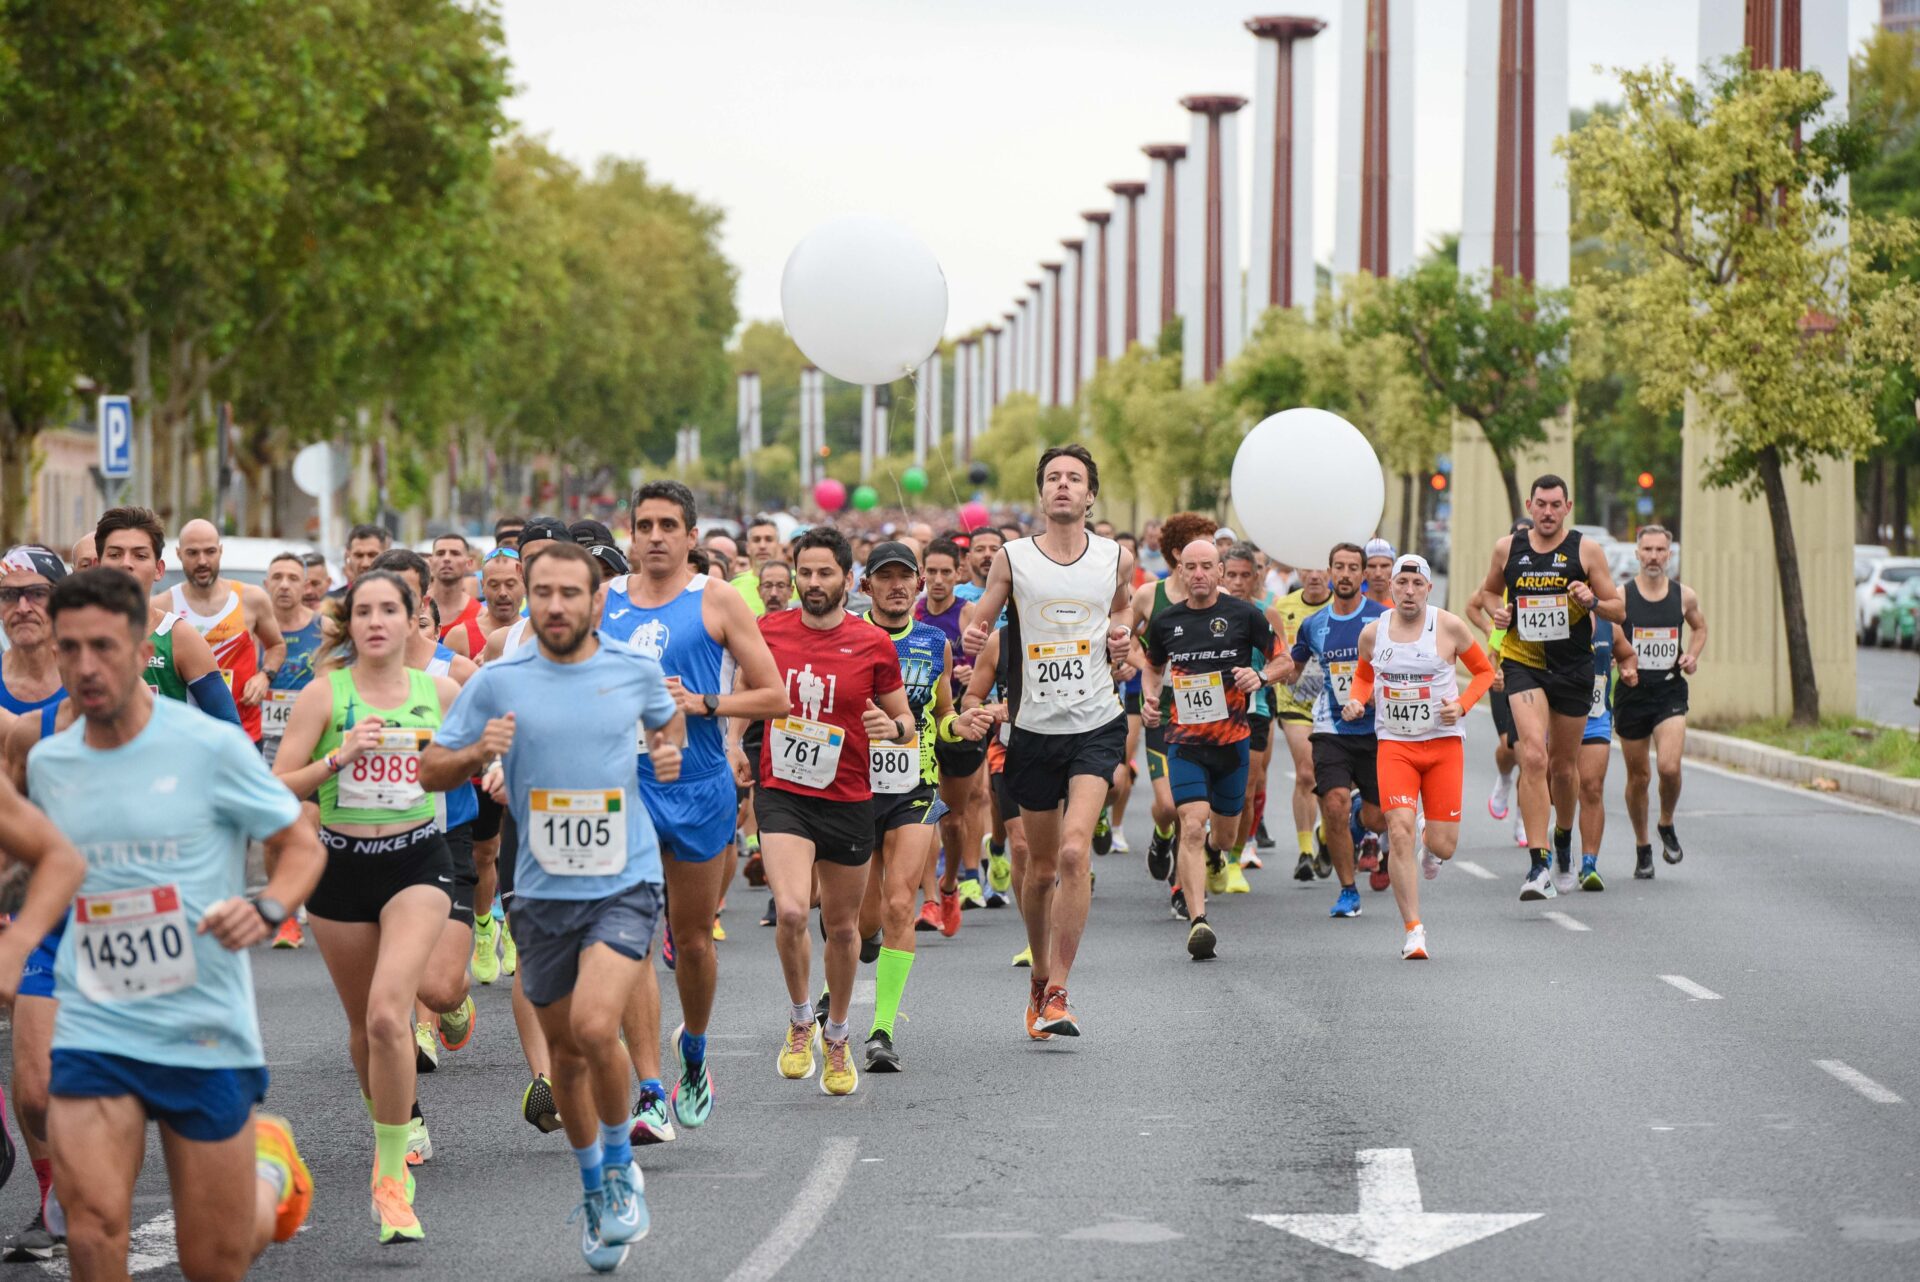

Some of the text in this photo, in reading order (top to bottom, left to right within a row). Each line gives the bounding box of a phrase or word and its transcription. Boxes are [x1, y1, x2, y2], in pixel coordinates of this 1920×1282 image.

[108, 407, 126, 466] P
[1515, 576, 1568, 588] ARUNCI
[1521, 611, 1566, 629] 14213
[1635, 643, 1676, 657] 14009
[1038, 660, 1084, 683] 2043
[1184, 690, 1213, 708] 146
[1386, 703, 1430, 721] 14473
[784, 736, 820, 766] 761
[353, 755, 420, 783] 8989
[543, 818, 610, 846] 1105
[353, 834, 409, 854] NIKE
[81, 924, 183, 969] 14310
